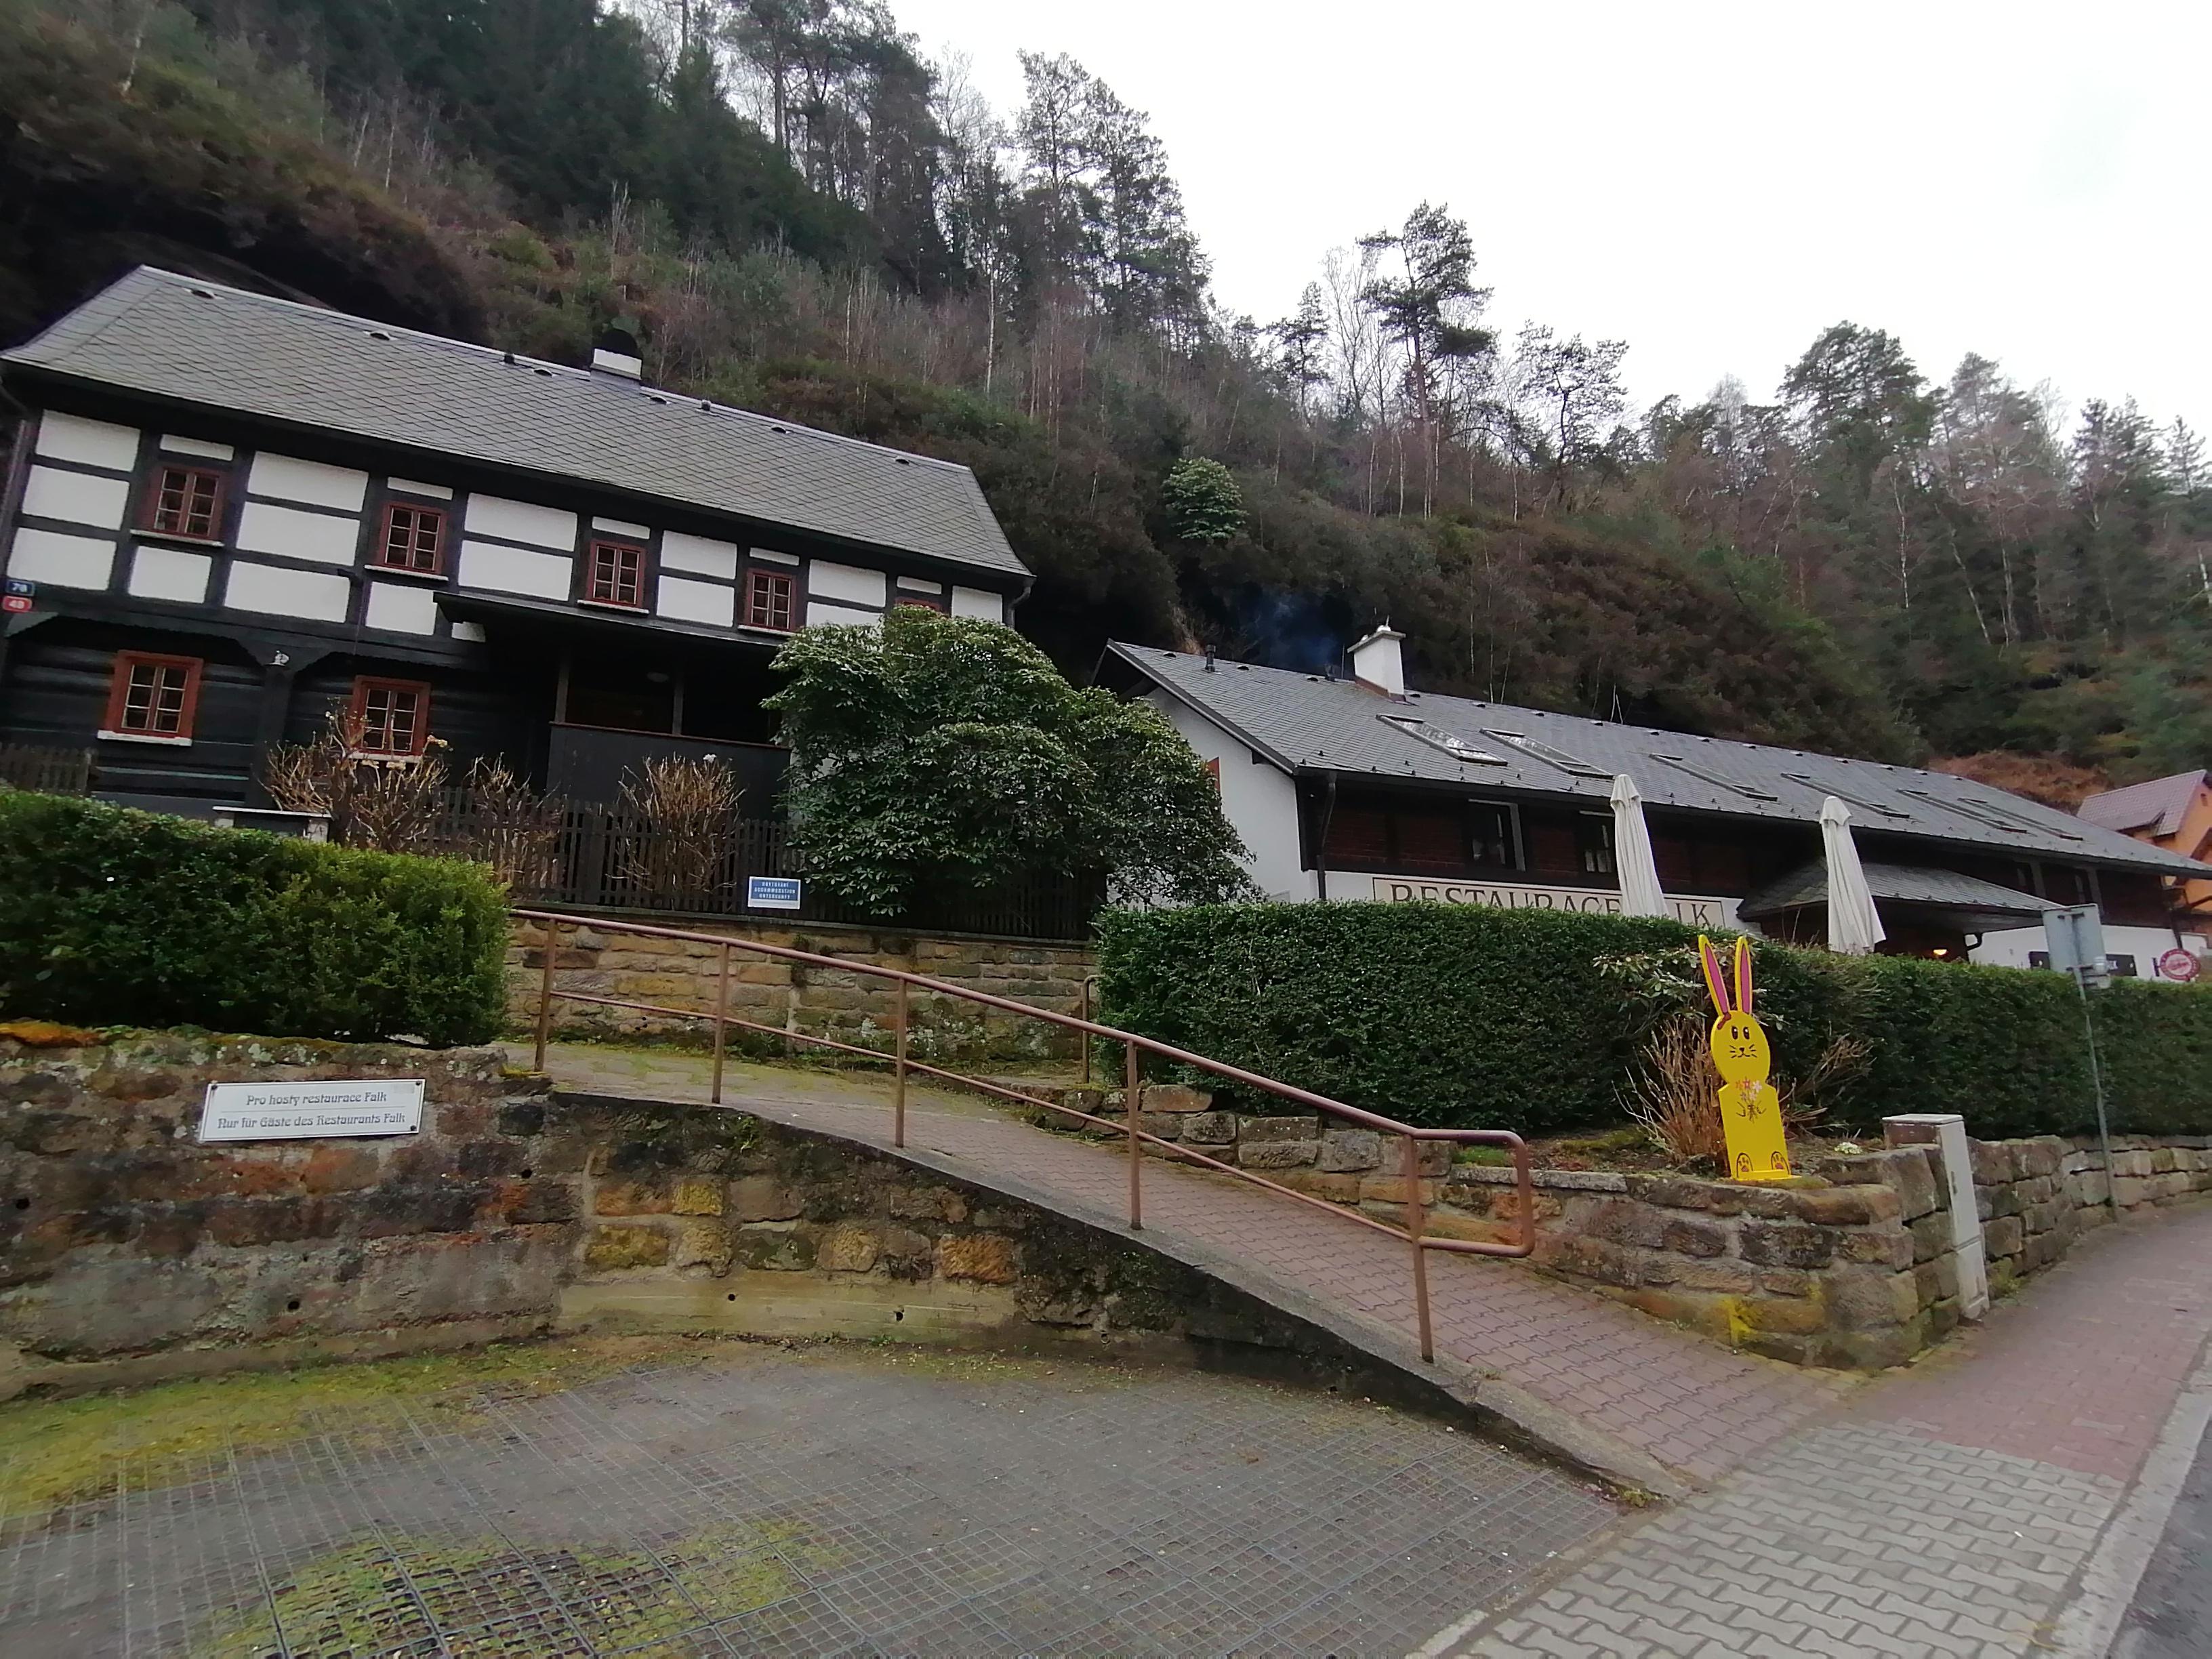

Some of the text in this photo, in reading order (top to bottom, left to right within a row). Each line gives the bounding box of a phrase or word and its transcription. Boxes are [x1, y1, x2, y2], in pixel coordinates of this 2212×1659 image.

[246, 1091, 387, 1106] Pro hosty restaurace Falk
[241, 1117, 258, 1128] für
[260, 1116, 291, 1127] Gäste
[293, 1115, 313, 1126] des
[316, 1113, 381, 1125] Restaurants
[383, 1112, 405, 1123] Falk
